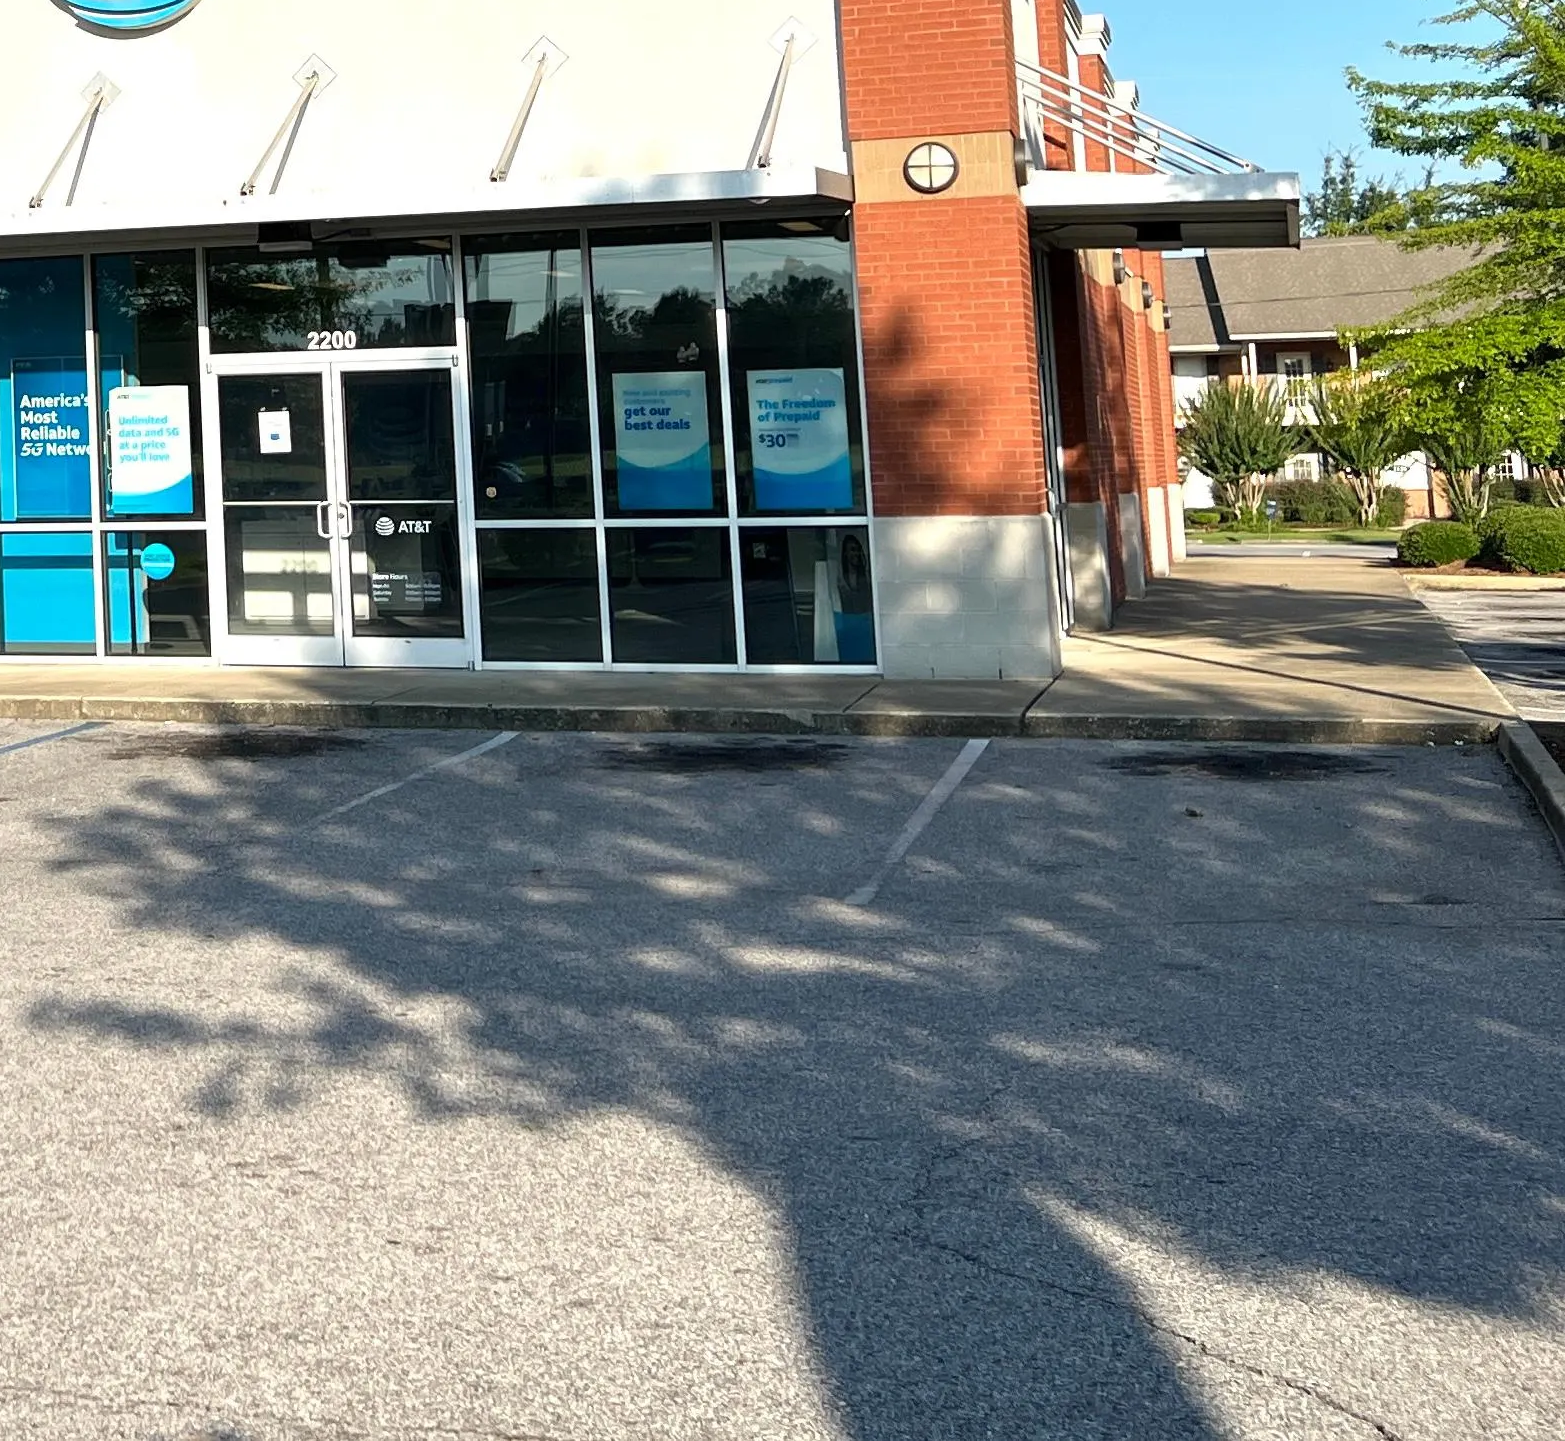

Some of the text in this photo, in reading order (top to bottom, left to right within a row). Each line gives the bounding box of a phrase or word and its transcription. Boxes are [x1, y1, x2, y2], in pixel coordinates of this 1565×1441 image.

[307, 330, 357, 350] 2200
[756, 398, 836, 410] The Freedom
[20, 410, 58, 424] Most
[624, 406, 671, 420] get our
[757, 410, 820, 423] of Prepaid
[118, 415, 168, 426] Unlimited
[624, 418, 691, 431] best deals
[20, 425, 80, 440] Reliable
[118, 427, 180, 438] data and 5G
[119, 440, 130, 450] at
[141, 440, 166, 453] price
[758, 433, 786, 448] $30
[20, 442, 44, 456] 5G
[398, 520, 432, 534] AT&T
